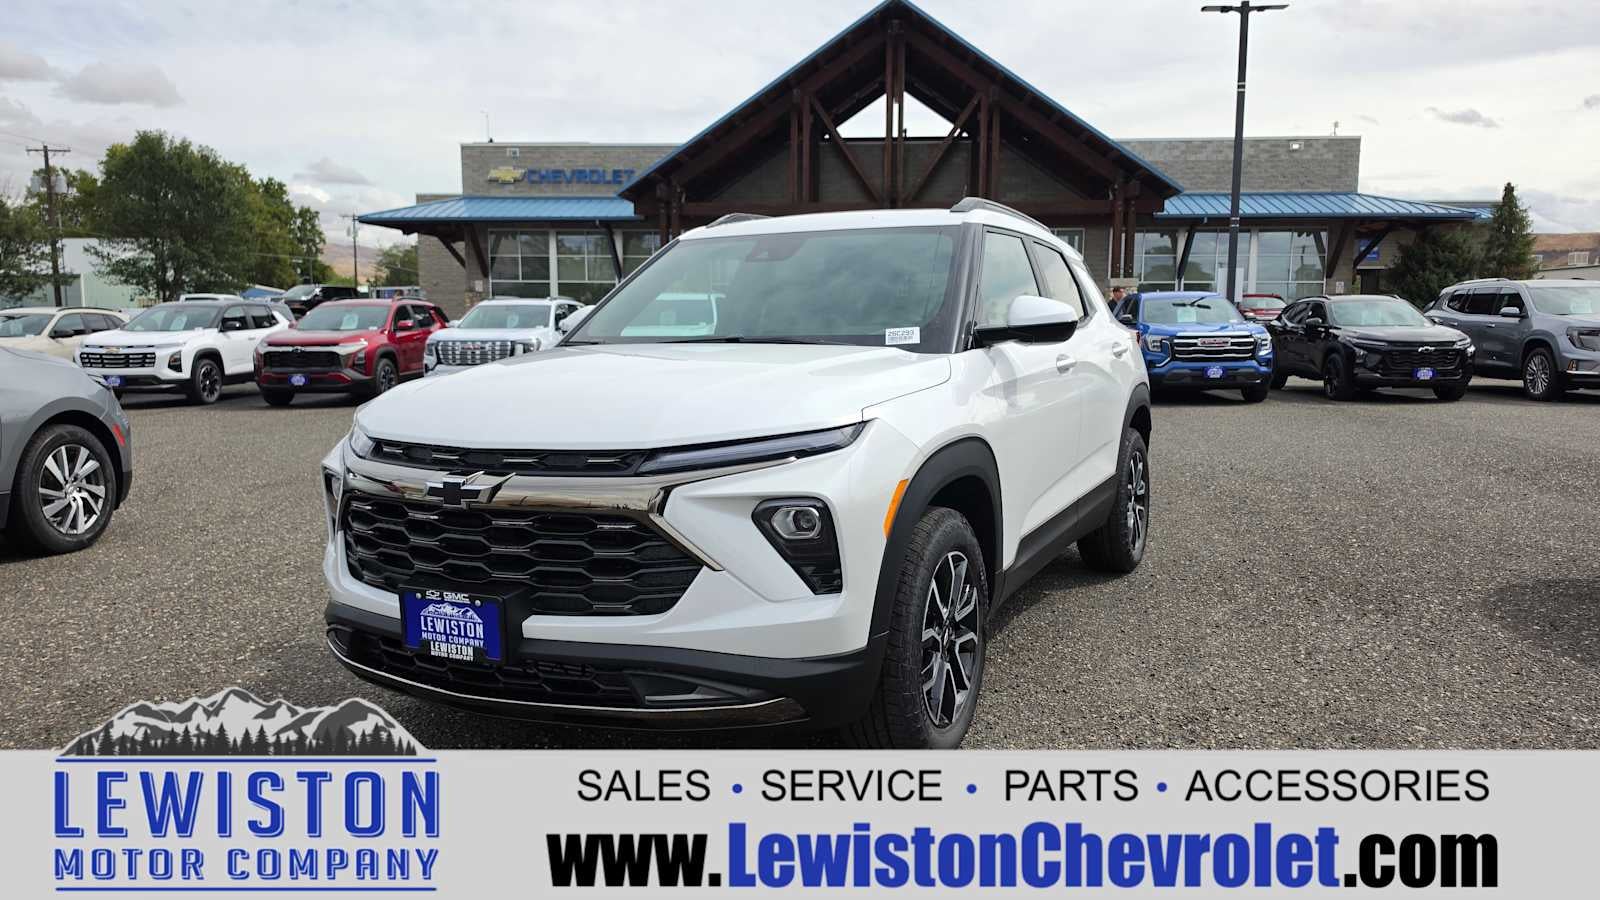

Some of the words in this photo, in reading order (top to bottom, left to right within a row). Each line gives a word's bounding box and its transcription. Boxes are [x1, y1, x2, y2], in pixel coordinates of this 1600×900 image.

[527, 168, 635, 185] CHEVROLET
[443, 592, 469, 602] GMC
[421, 615, 484, 639] LEWISTON
[422, 632, 447, 641] MOTOR
[448, 635, 484, 648] COMPANY
[431, 641, 474, 656] LEWISTON
